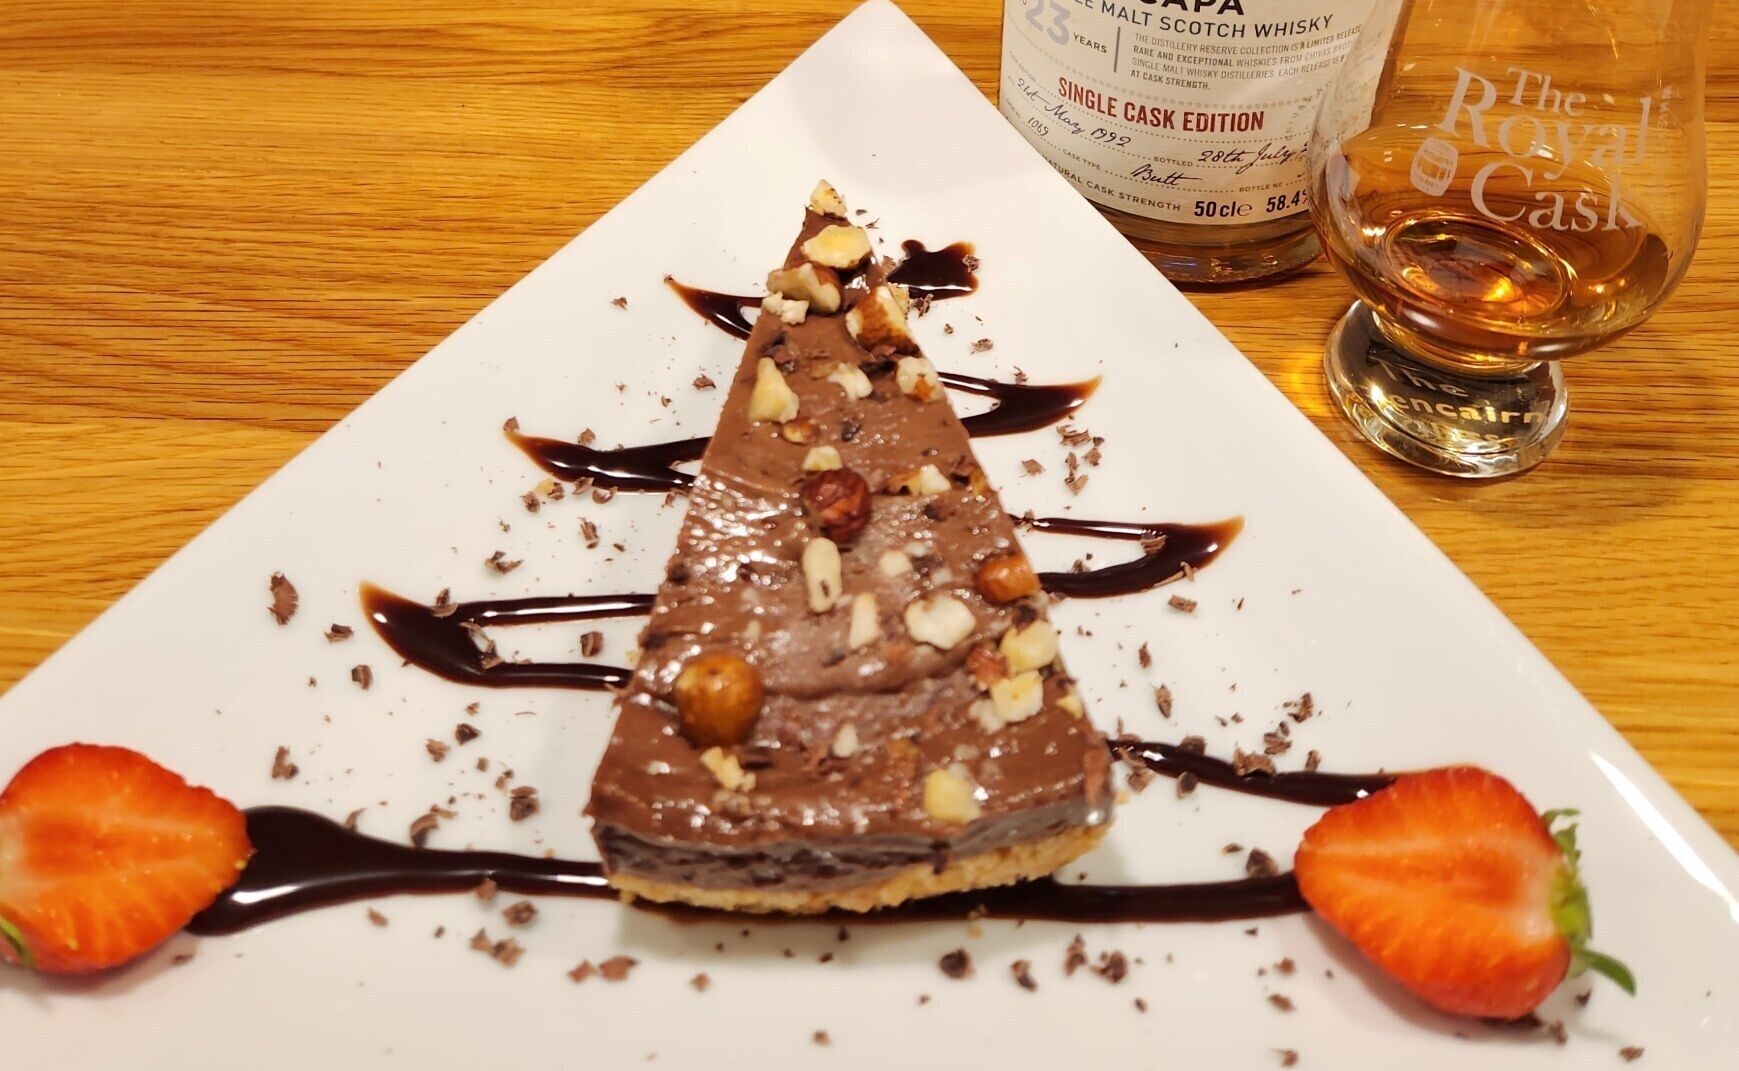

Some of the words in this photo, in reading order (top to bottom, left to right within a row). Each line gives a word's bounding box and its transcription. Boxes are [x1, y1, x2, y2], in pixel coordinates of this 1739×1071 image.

[1101, 0, 1153, 27] MALT
[1159, 16, 1246, 38] SCOTCH
[1254, 13, 1334, 38] WHISKY
[1073, 32, 1108, 54] YEARS
[1135, 33, 1150, 44] THE
[1151, 36, 1198, 52] DISTILLERY
[1199, 44, 1237, 55] RESERVE
[1240, 44, 1289, 55] COLLECTION
[1306, 35, 1335, 49] LIMITED
[1133, 45, 1154, 58] RARE
[1157, 50, 1174, 61] AND
[1176, 54, 1233, 67] EXCEPTIONAL
[1236, 57, 1277, 68] WHISKIES
[1280, 54, 1303, 65] FROM
[1132, 57, 1159, 72] SINGLE
[1163, 64, 1184, 75] MALT
[1186, 68, 1219, 79] WHISKY
[1278, 66, 1299, 77] EACH
[1300, 58, 1331, 73] RELEASE
[1131, 69, 1141, 78] AT
[1142, 72, 1163, 84] CASK
[1165, 77, 1211, 90] STRENGTH.
[1507, 66, 1587, 117] The
[1058, 76, 1118, 118] SINGLE
[1123, 101, 1175, 130] CASK
[1182, 110, 1264, 133] EDITION
[1433, 65, 1652, 181] Royal
[1090, 127, 1131, 148] 1992
[1062, 149, 1081, 163] CASK
[1082, 158, 1101, 171] TYPE
[1153, 155, 1194, 167] BOTTLED
[1087, 180, 1115, 197] CASK
[1118, 192, 1181, 212] STRENGTH
[1239, 184, 1269, 193] BOTTLE
[1470, 161, 1645, 233] Cask
